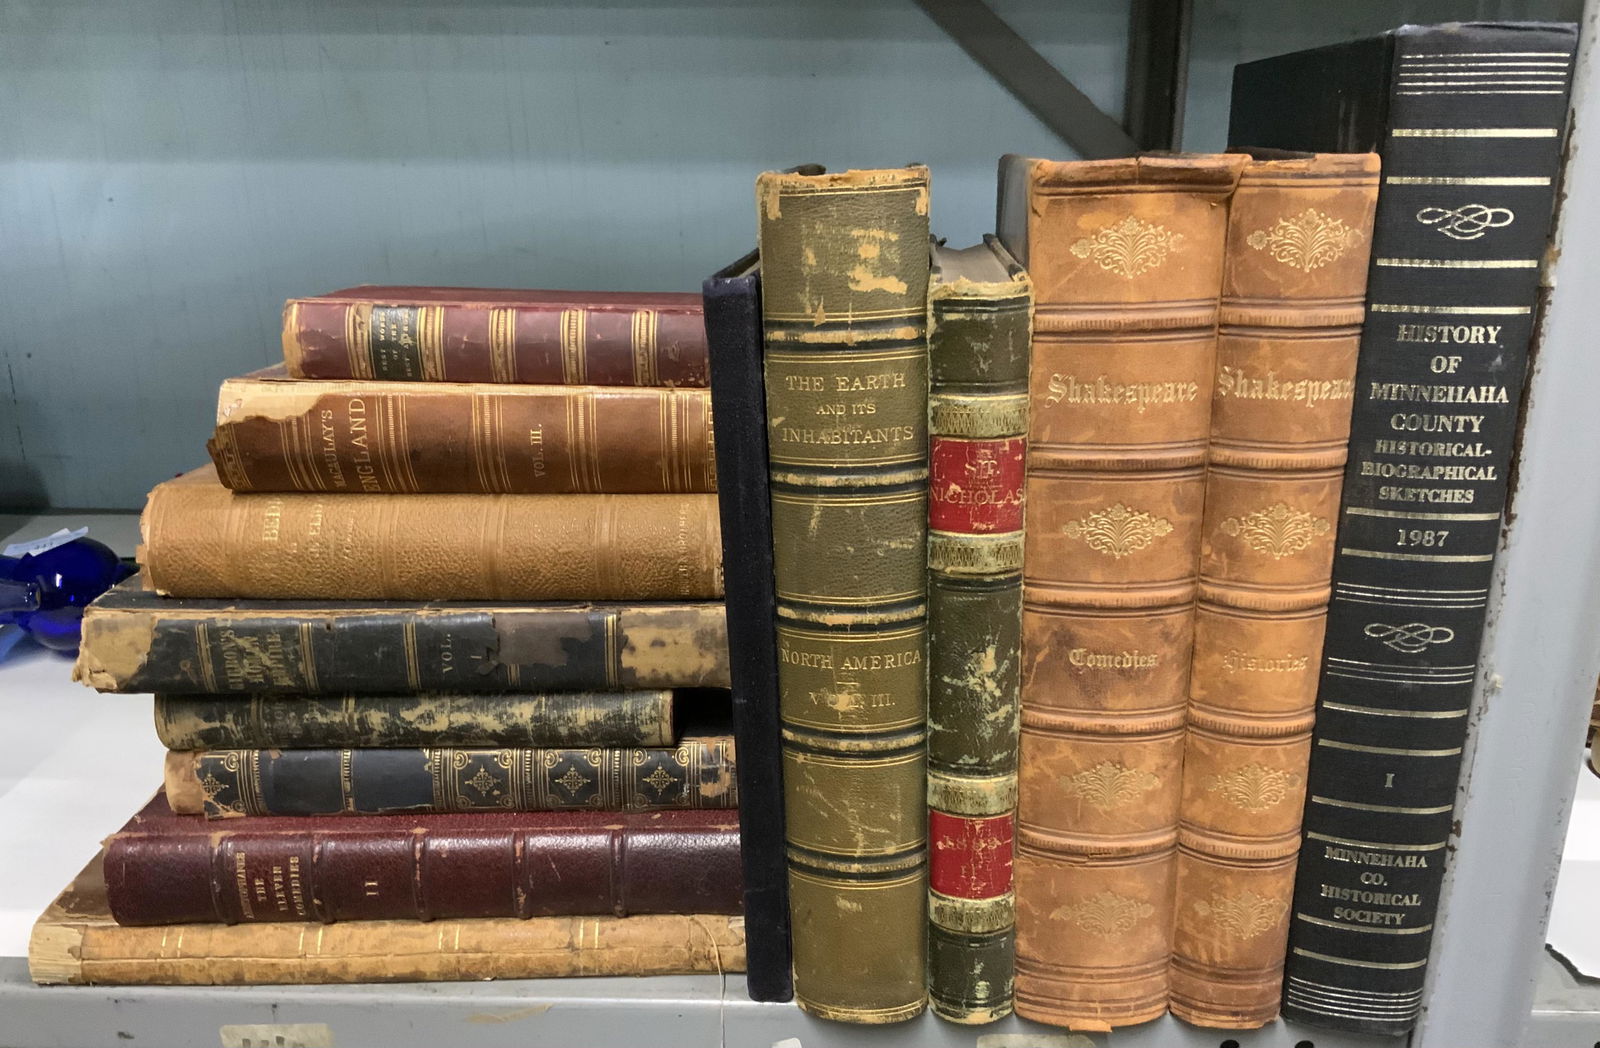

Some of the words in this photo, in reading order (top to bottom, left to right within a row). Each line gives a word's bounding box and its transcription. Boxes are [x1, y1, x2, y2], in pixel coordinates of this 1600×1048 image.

[1397, 325, 1502, 344] HISTORY
[393, 349, 398, 360] OF
[1430, 356, 1462, 373] OF
[786, 375, 824, 392] THE
[836, 373, 906, 392] EARTH
[1045, 373, 1199, 413] Shakespeare
[1370, 382, 1509, 403] MINNEHAHA
[816, 404, 846, 415] AND
[851, 404, 876, 414] ITS
[1390, 414, 1485, 432] COUNTY
[530, 424, 542, 446] III.
[782, 426, 914, 444] INHABITANTS
[321, 409, 347, 488] MACAULAY'S
[348, 398, 380, 492] ENGLAND
[532, 448, 546, 477] VOL.
[1361, 463, 1497, 480] BIOGRAPHICAL
[1379, 488, 1475, 503] SKETCHES
[1397, 529, 1449, 547] 1987
[440, 633, 453, 673] VOL.
[781, 649, 833, 669] NORTH
[841, 650, 922, 670] AMERICA
[1068, 648, 1158, 668] Comedies
[871, 693, 896, 707] III.
[1324, 846, 1427, 868] MINNEHAHA
[273, 866, 288, 911] ELEVEN
[290, 856, 306, 916] COMEDIES
[1360, 873, 1387, 887] CO.
[1321, 884, 1421, 906] HISTORICAL
[1334, 907, 1405, 925] SOCIETY
